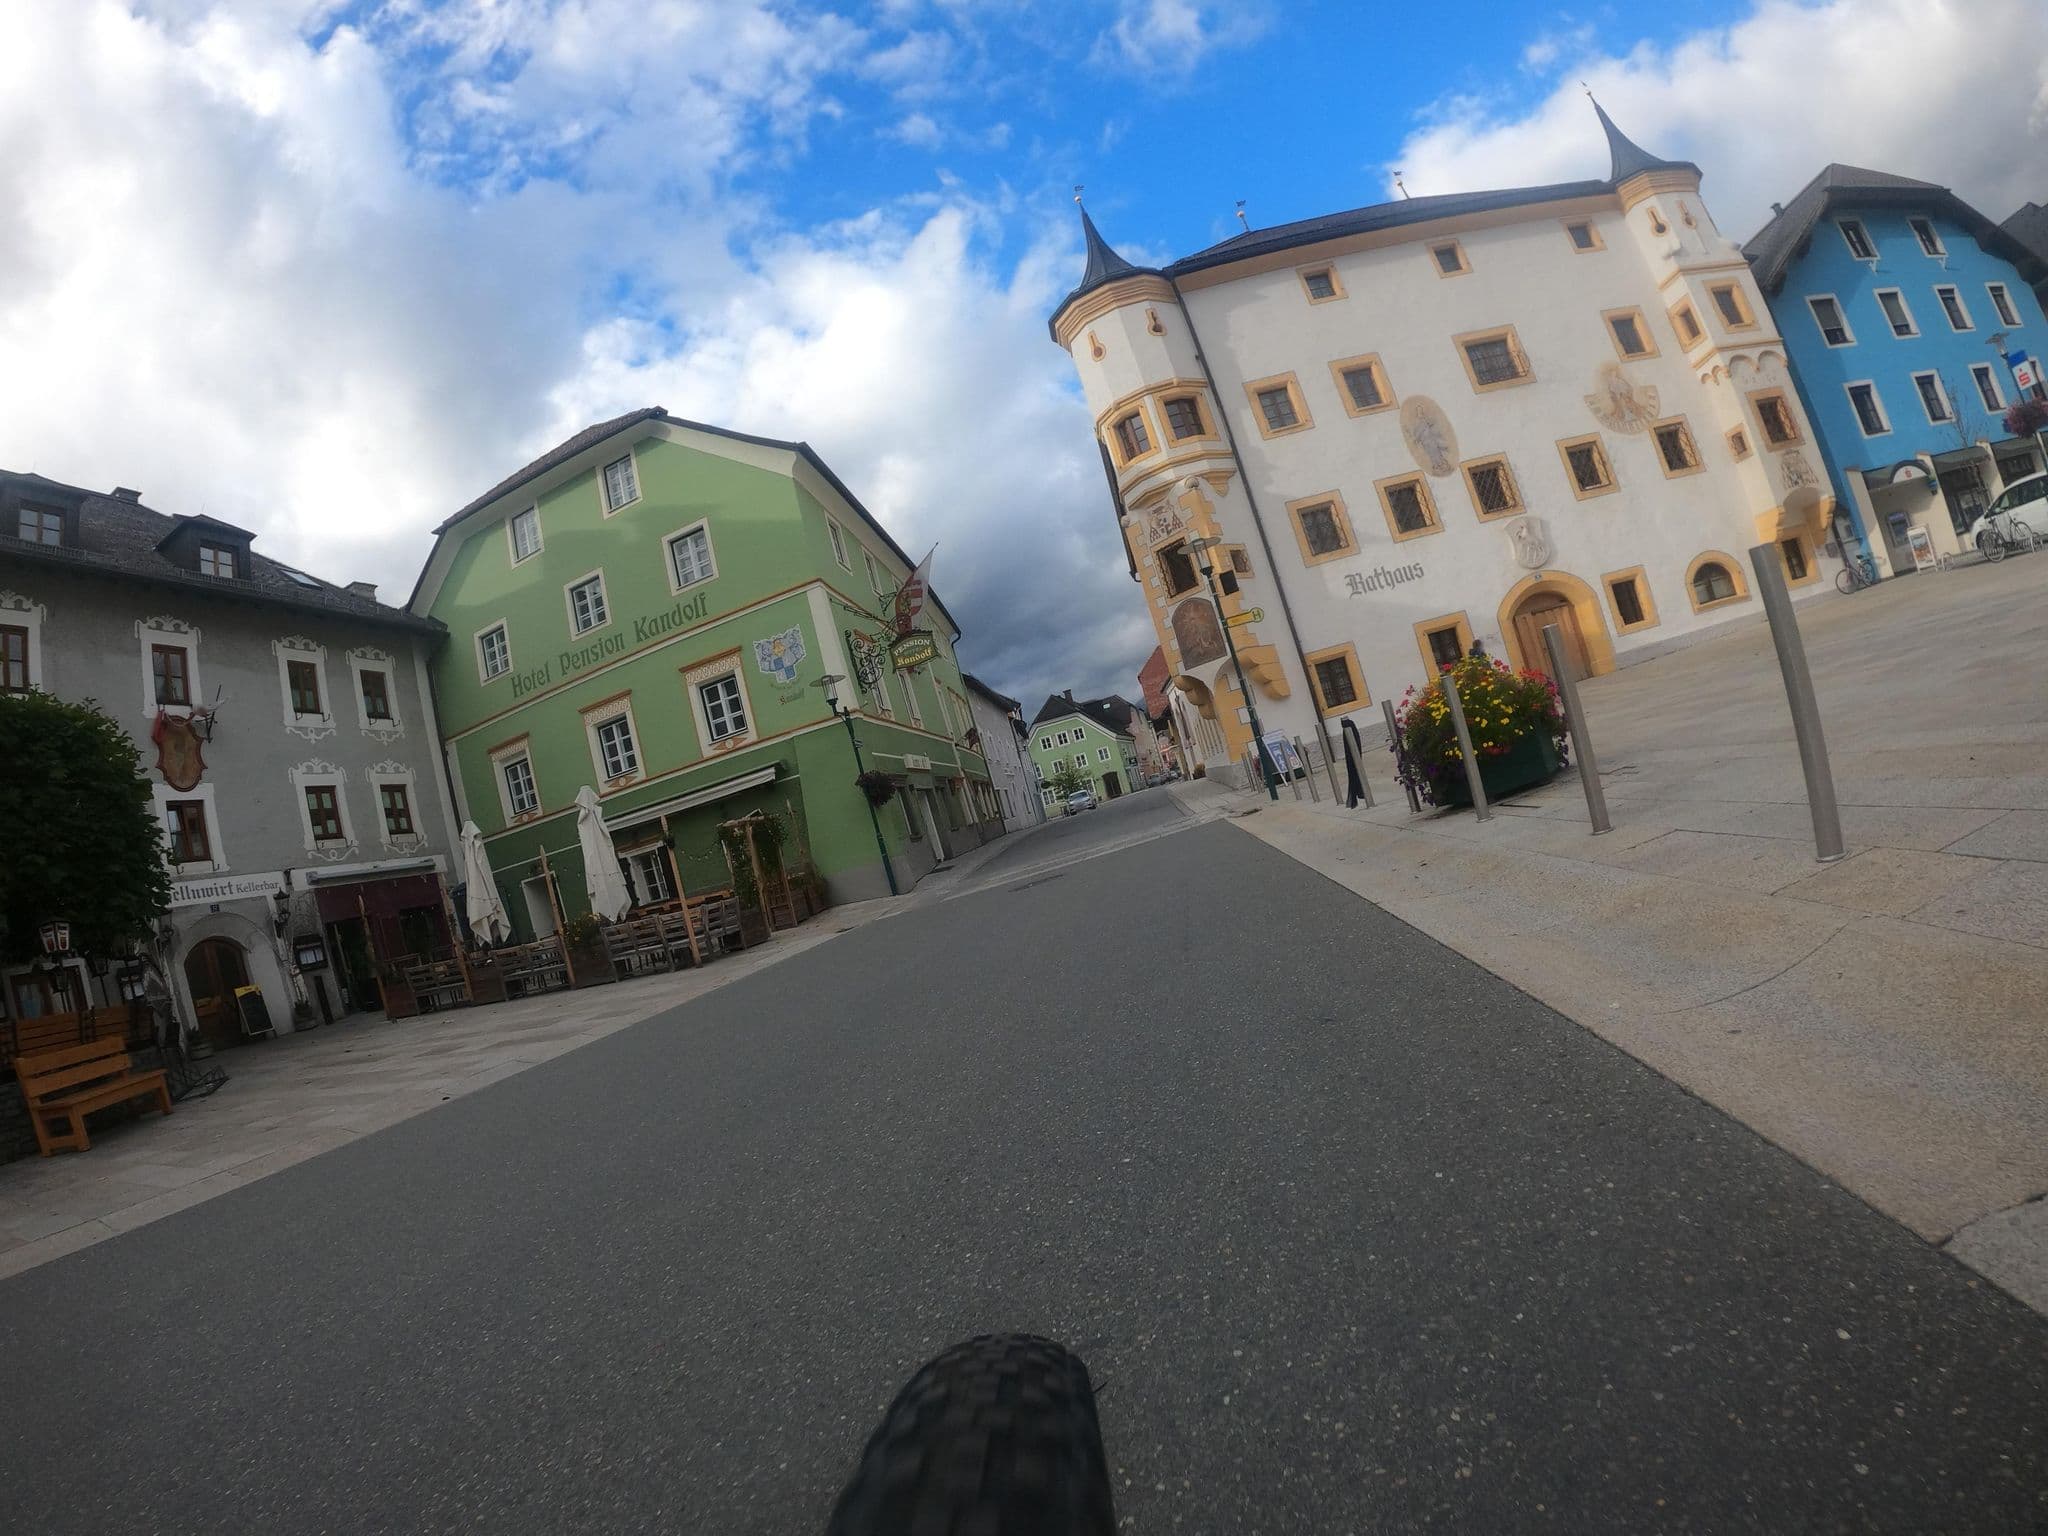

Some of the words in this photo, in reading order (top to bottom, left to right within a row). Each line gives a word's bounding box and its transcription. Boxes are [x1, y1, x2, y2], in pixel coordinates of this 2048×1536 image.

[1344, 562, 1425, 600] Rathaus
[510, 663, 552, 698] Hotel
[559, 633, 626, 676] Pension
[633, 592, 709, 643] Kandolf
[894, 639, 930, 656] PENSION
[172, 881, 234, 903] ellnwirt
[236, 880, 280, 894] Kellerbar
